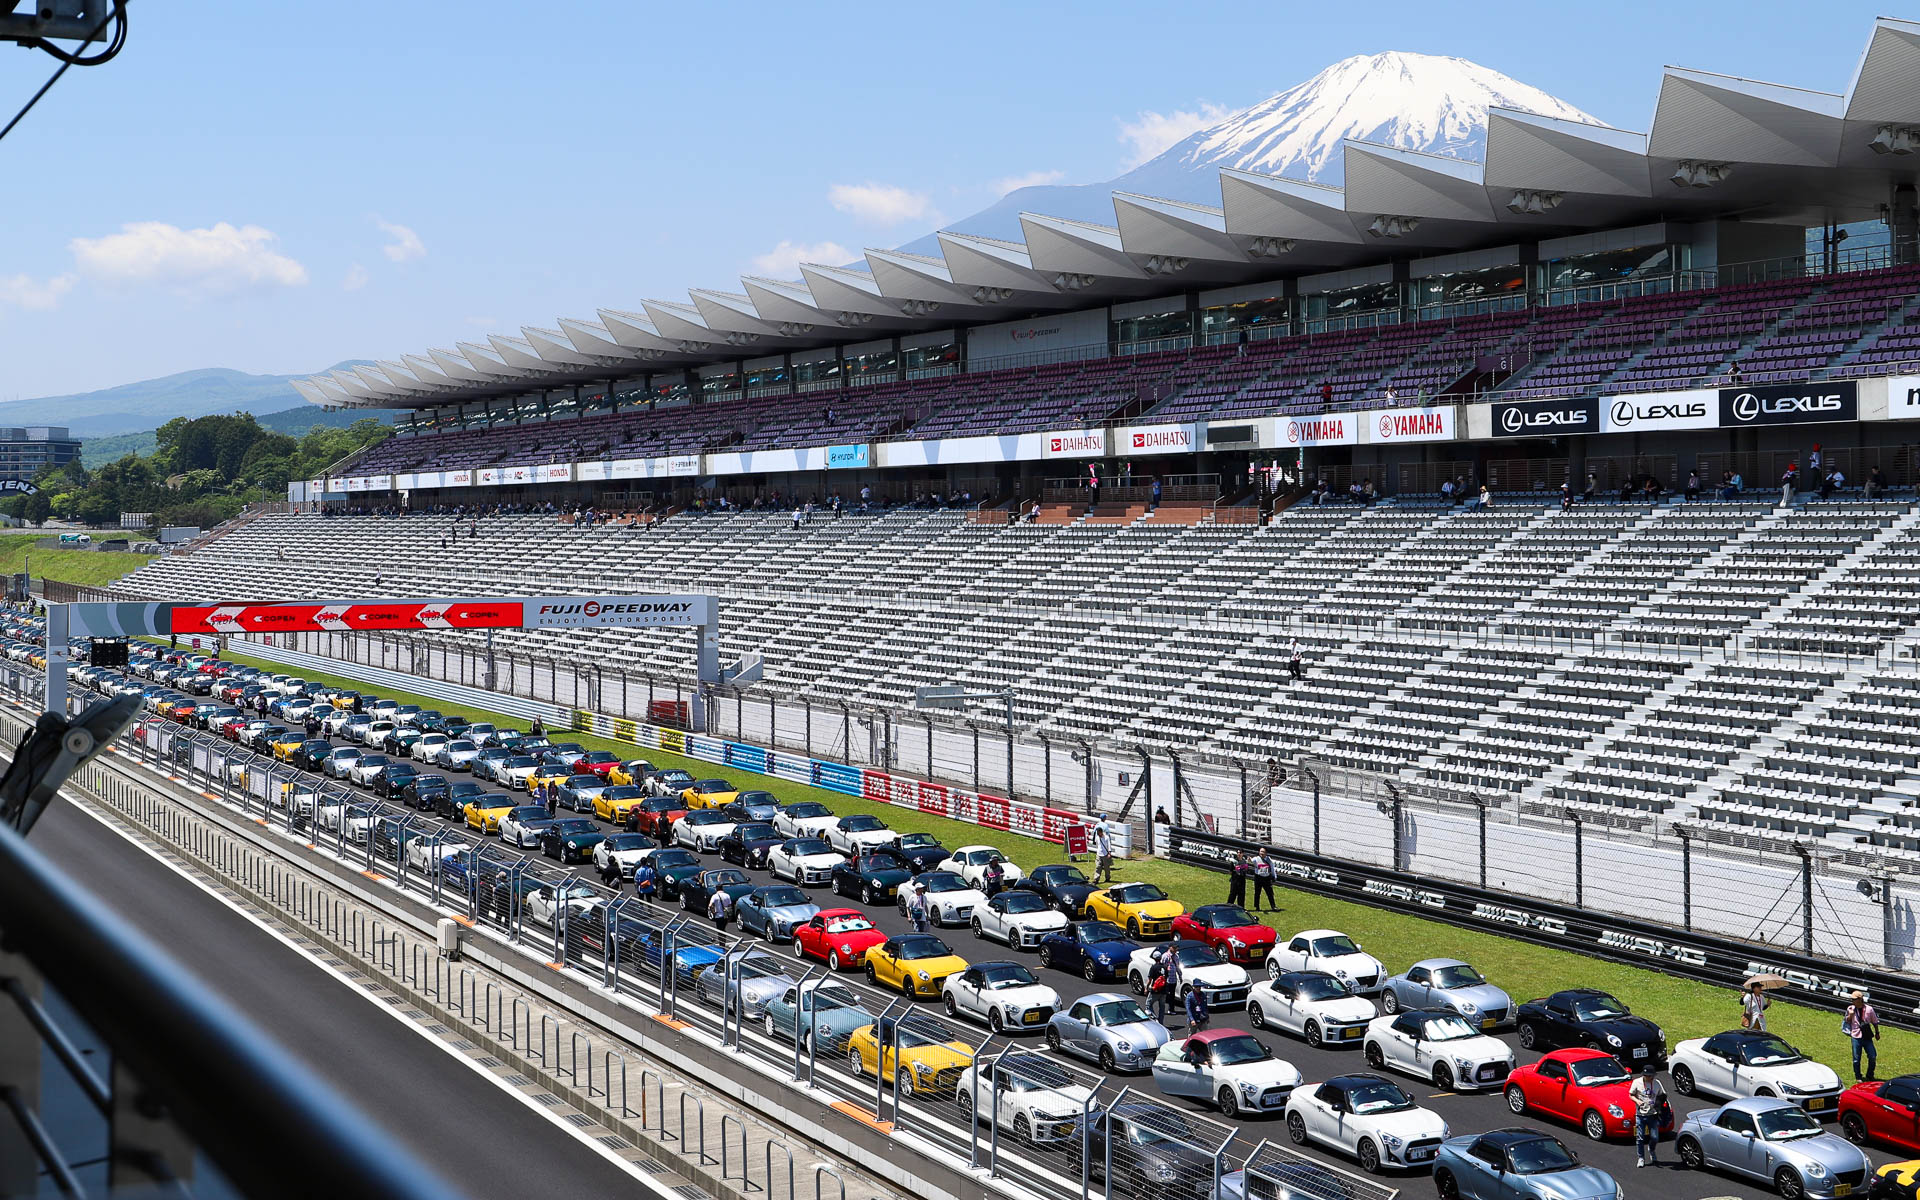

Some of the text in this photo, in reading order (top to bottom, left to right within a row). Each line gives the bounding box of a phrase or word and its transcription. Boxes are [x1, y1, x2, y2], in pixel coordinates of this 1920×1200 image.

[1636, 403, 1706, 420] LEXUS
[1761, 394, 1842, 414] LEXUS
[1394, 413, 1443, 436] YAMAHA
[1524, 409, 1588, 426] LEXUS
[1146, 431, 1191, 447] DAIHATSU
[1300, 420, 1344, 441] YAMAHA
[1063, 436, 1103, 451] DAIHATSU
[453, 474, 469, 482] HONDA
[549, 468, 569, 478] HONDA
[539, 601, 692, 618] FUJI SPEEDWAY
[601, 615, 692, 623] MOTORSPORTS
[1288, 863, 1339, 885] AMG
[1387, 885, 1446, 909] AMG
[1500, 909, 1567, 935] AMG
[1630, 937, 1707, 966] AMG
[1786, 969, 1870, 1002] AMG
